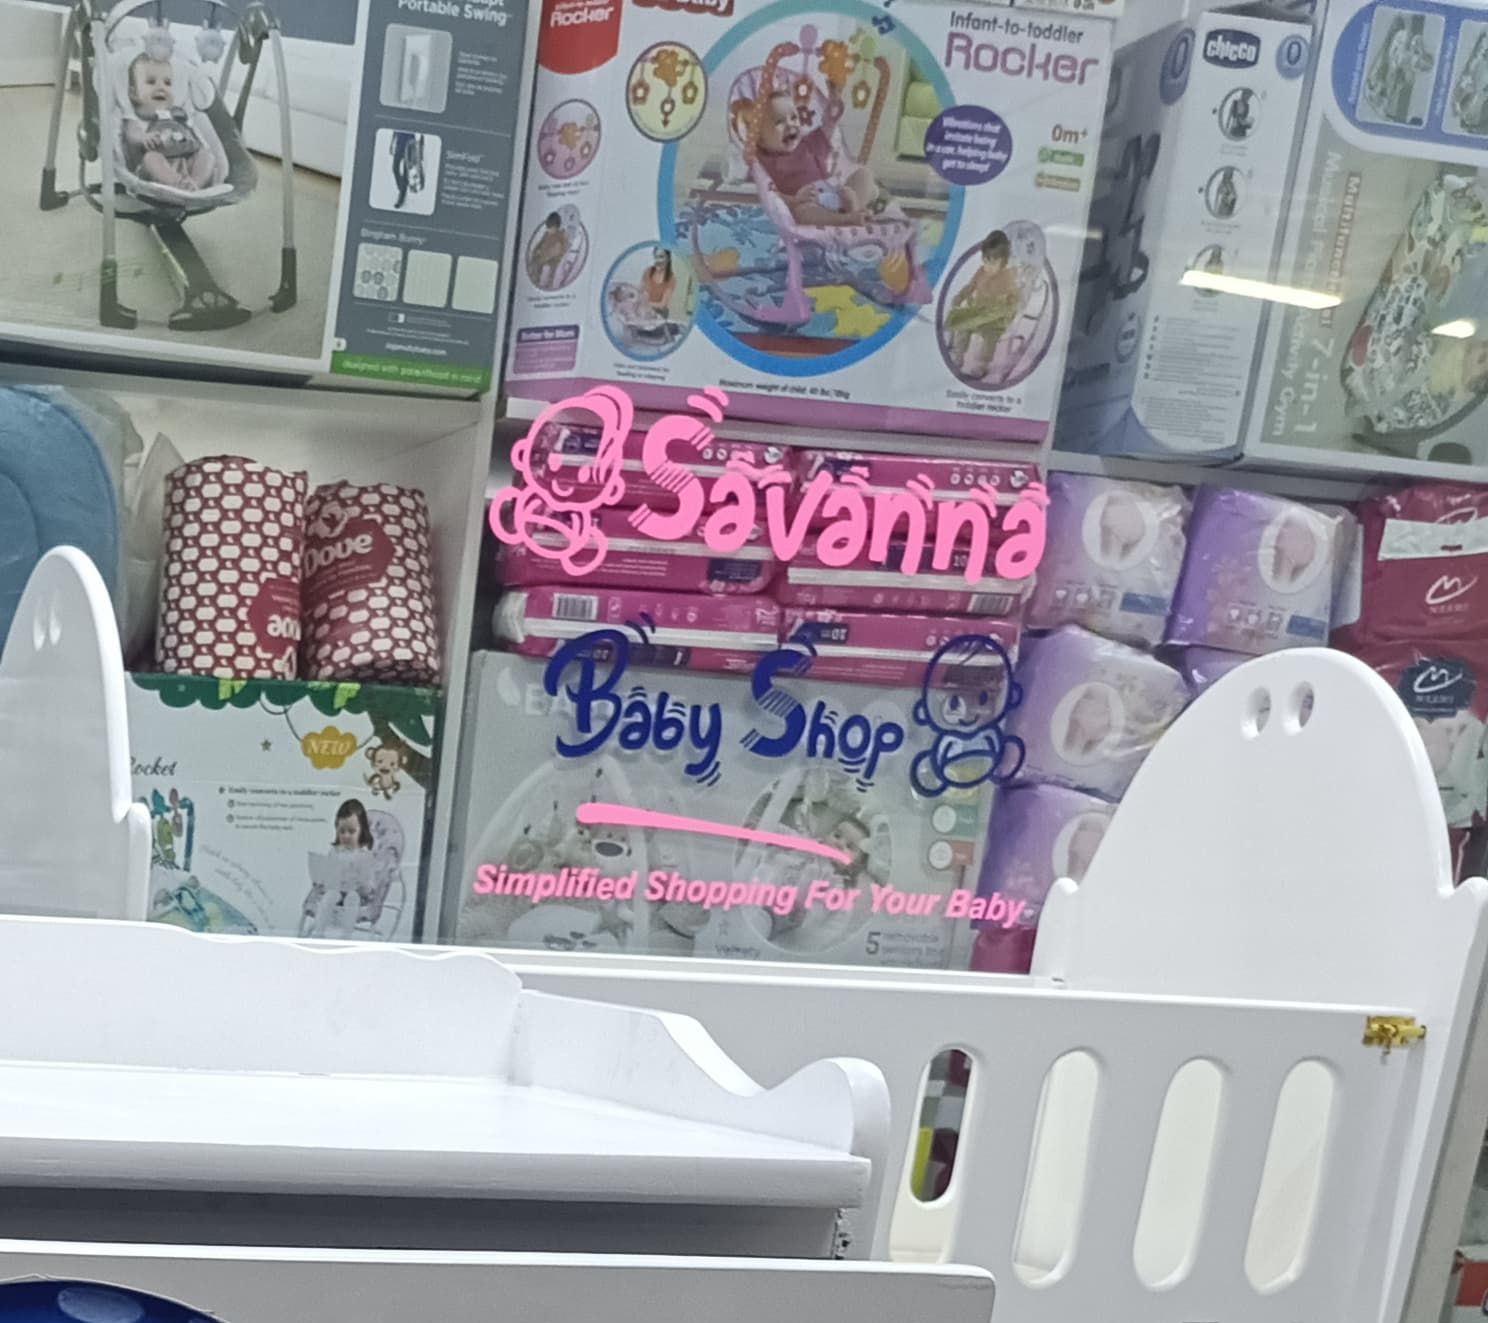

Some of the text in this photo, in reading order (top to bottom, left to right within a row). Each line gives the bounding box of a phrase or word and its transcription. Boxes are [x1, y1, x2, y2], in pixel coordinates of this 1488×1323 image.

[463, 4, 507, 27] Swing
[550, 6, 614, 28] Rocker
[949, 11, 1084, 44] Infant-to-toddler
[944, 31, 1100, 86] Rocker
[627, 410, 1049, 585] Savanna
[543, 628, 905, 781] Baby Shop
[308, 739, 352, 755] NEW
[473, 863, 1026, 929] Simplified Shopping For Your Baby
